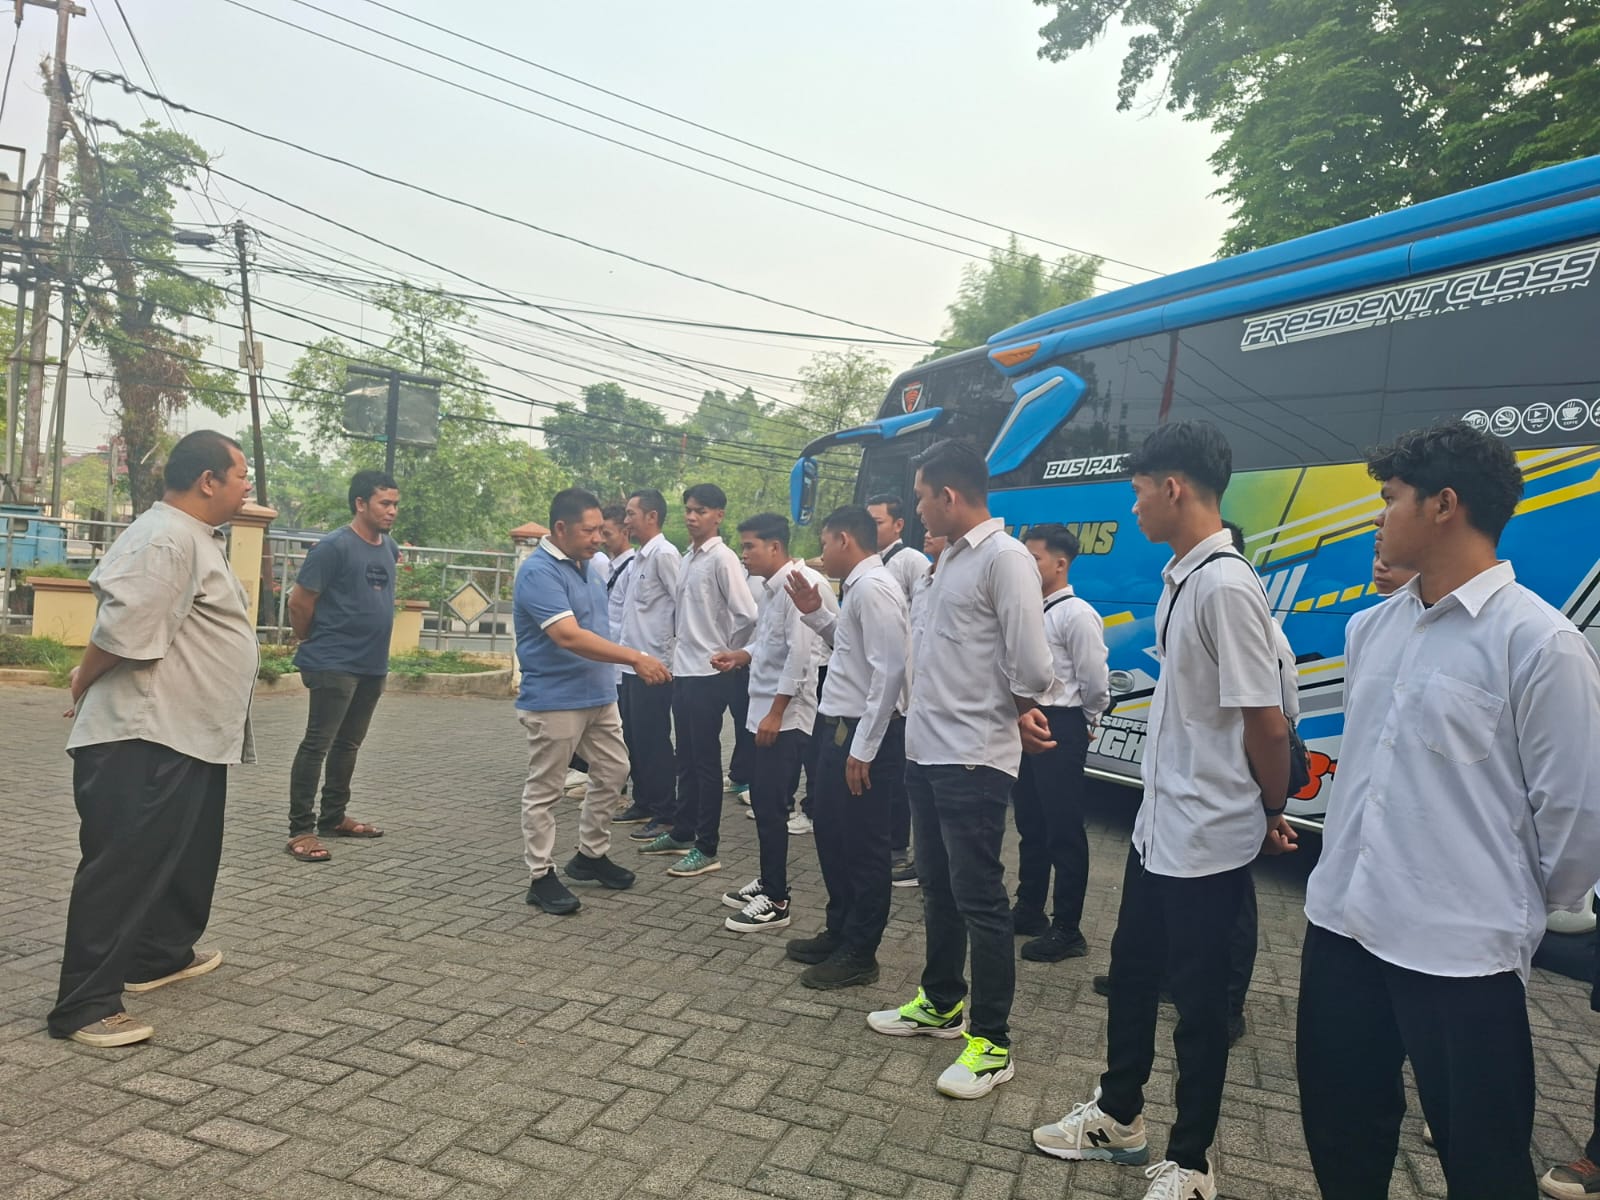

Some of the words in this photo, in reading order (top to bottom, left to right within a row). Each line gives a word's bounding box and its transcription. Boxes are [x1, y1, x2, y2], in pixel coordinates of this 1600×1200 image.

[1376, 303, 1471, 327] SPECIAL
[1481, 280, 1590, 306] EDITION
[1043, 458, 1088, 479] BUS
